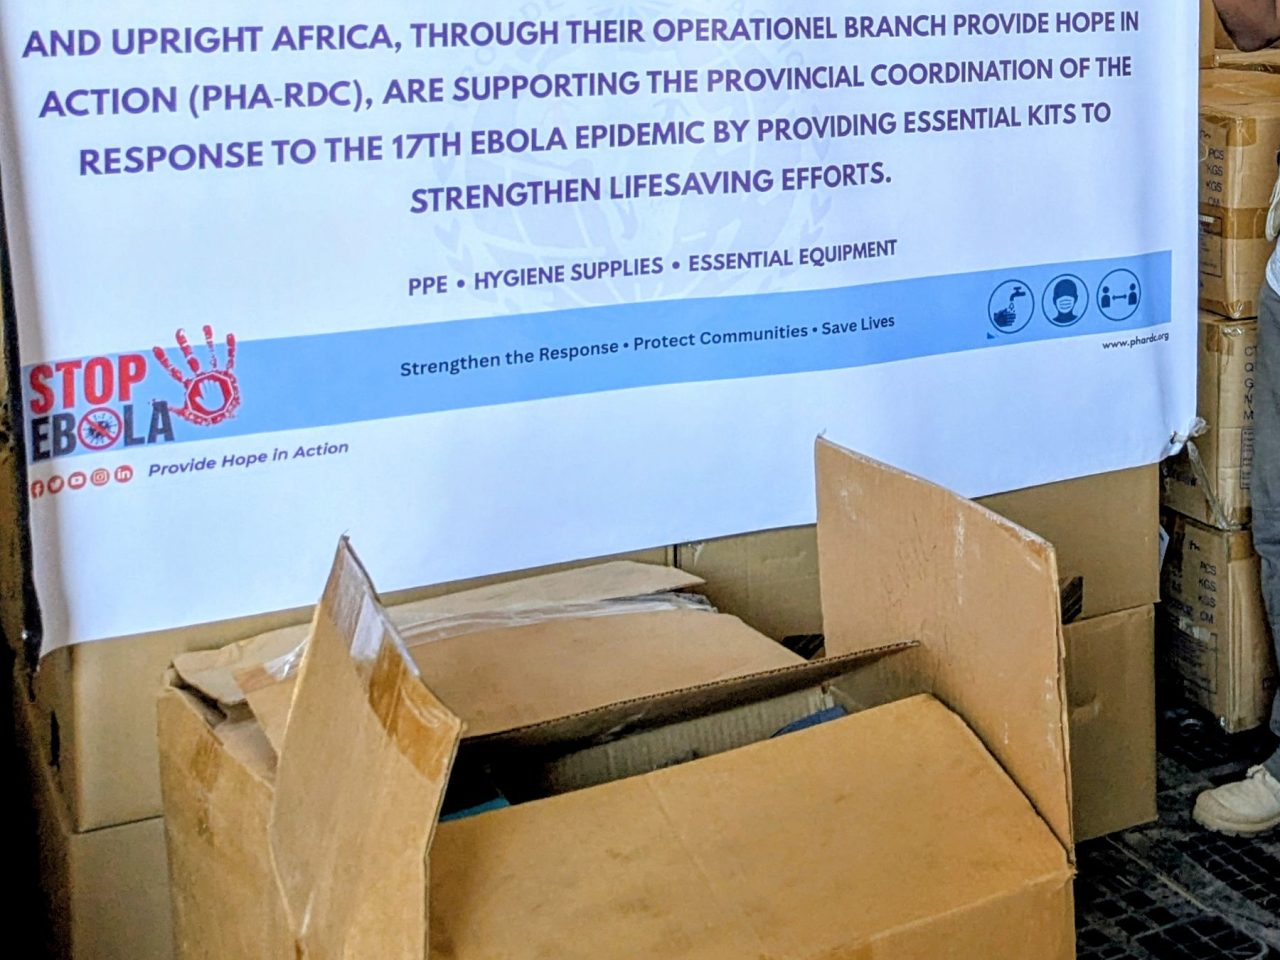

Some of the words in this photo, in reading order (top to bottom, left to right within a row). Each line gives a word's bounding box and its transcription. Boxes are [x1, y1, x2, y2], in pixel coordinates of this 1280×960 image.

[21, 29, 101, 59] AND
[111, 25, 264, 56] UPRIGHT
[271, 23, 402, 54] AFRICA,
[409, 20, 559, 48] THROUGH
[565, 19, 646, 45] THEIR
[652, 16, 838, 43] OPERATIONEL
[844, 14, 946, 39] BRANCH
[953, 12, 1049, 36] PROVIDE
[1055, 11, 1116, 34] HOPE
[1120, 10, 1139, 32] IN
[37, 86, 177, 119] ACTION
[189, 79, 373, 119] (PHA-RDC),
[382, 77, 444, 105] ARE
[451, 70, 640, 102] SUPPORTING
[645, 69, 698, 94] THE
[707, 64, 865, 93] PROVINCIAL
[870, 58, 1053, 87] COORDINATION
[1059, 57, 1091, 79] OF
[1094, 55, 1132, 78] THE
[79, 140, 264, 176] RESPONSE
[270, 138, 317, 166] TO
[323, 135, 383, 163] THE
[392, 131, 461, 160] 17TH
[471, 126, 568, 155] EBOLA
[575, 120, 705, 150] EPIDEMIC
[713, 119, 751, 144] BY
[757, 111, 897, 142] PROVIDING
[903, 105, 1022, 134] ESSENTIAL
[1028, 102, 1077, 127] KITS
[1081, 101, 1112, 124] TO
[409, 177, 601, 214] STRENGTHEN
[609, 169, 774, 200] LIFESAVING
[781, 161, 892, 191] EFFORTS.
[408, 275, 448, 297] PPE
[474, 264, 565, 291] HYGIENE
[570, 256, 664, 282] SUPPLIES
[689, 249, 794, 272] ESSENTIAL
[799, 238, 898, 267] EQUIPMENT
[400, 354, 501, 377] Strengthen
[505, 349, 535, 365] the
[539, 341, 619, 363] Response
[633, 332, 696, 352] Protect
[699, 325, 809, 346] Communities
[821, 320, 858, 336] Save
[860, 315, 896, 332] Lives
[1102, 332, 1169, 349] www.phardc.org
[30, 354, 147, 415] STOP
[148, 458, 217, 478] Provide
[221, 450, 268, 470] Hope
[272, 447, 289, 463] in
[292, 442, 349, 460] Action
